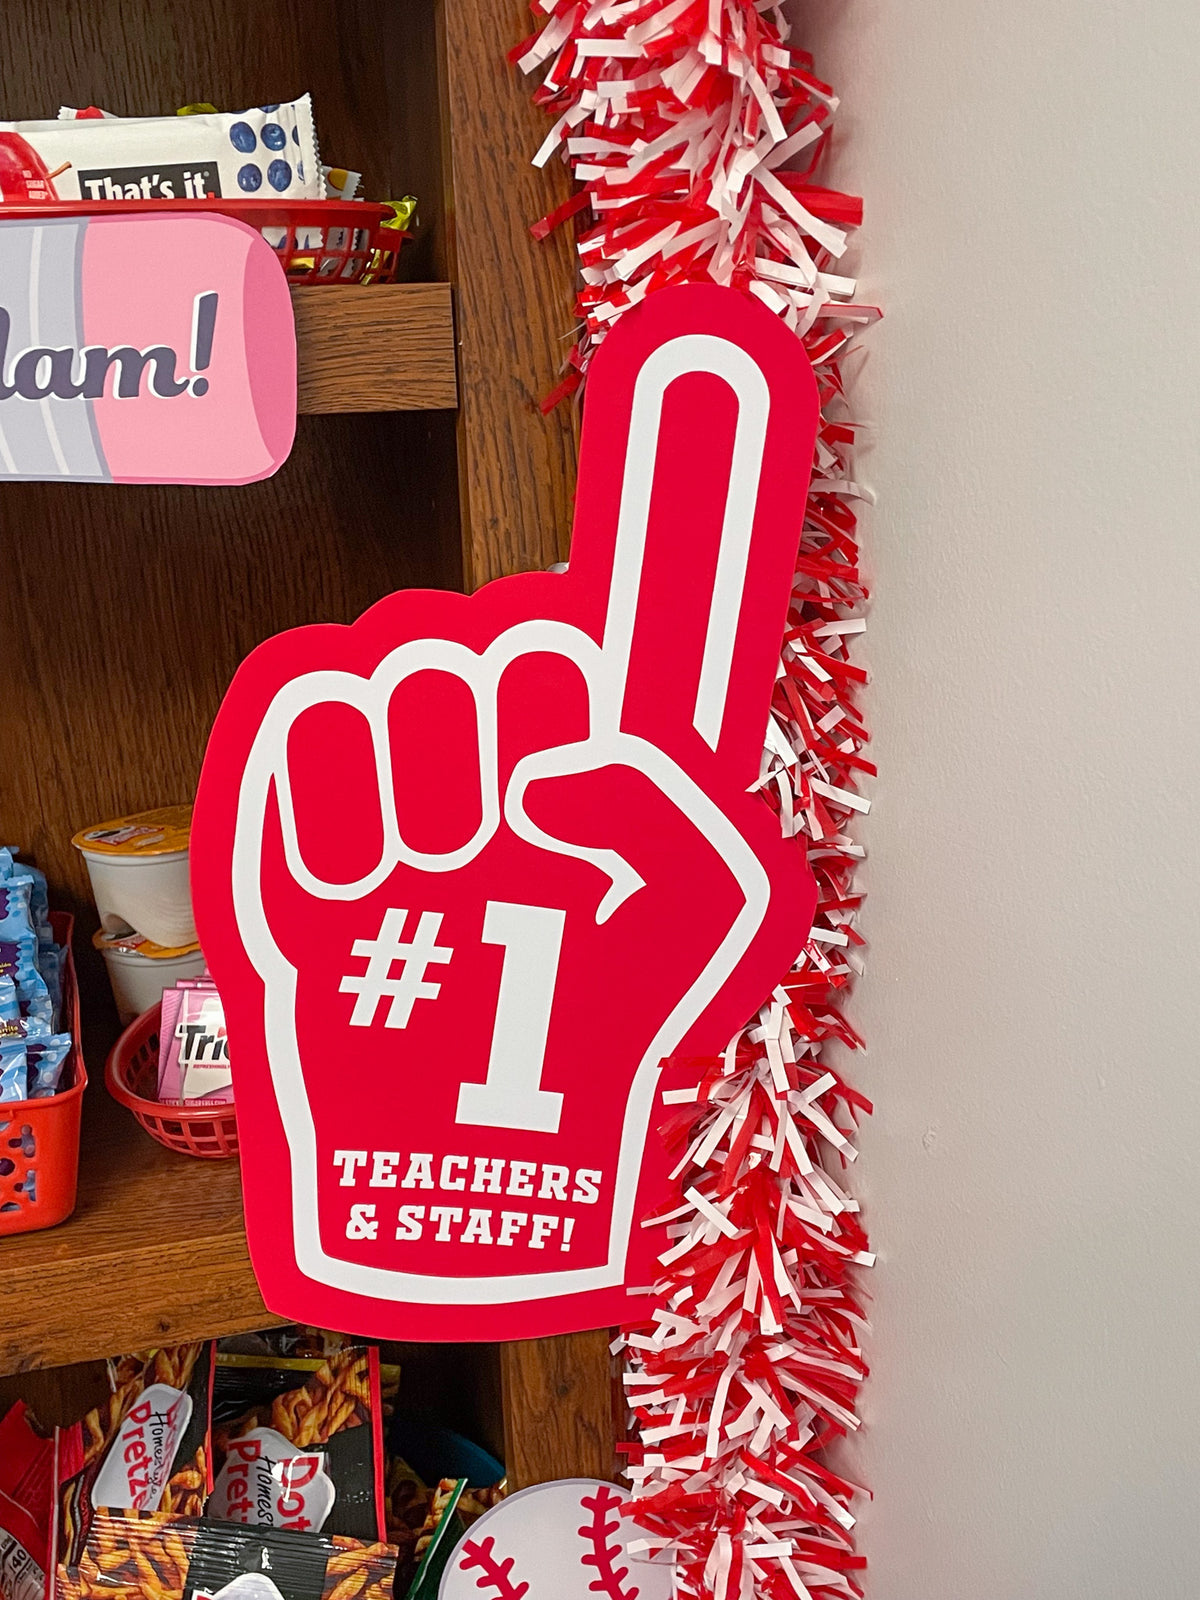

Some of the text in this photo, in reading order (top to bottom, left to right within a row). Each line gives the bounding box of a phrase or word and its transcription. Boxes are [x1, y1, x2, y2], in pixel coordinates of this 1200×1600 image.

[84, 174, 175, 200] That's
[338, 900, 567, 1134] #1
[333, 1150, 602, 1204] TEACHERS
[345, 1204, 576, 1252] & STAFF!
[227, 1440, 261, 1523] Pret
